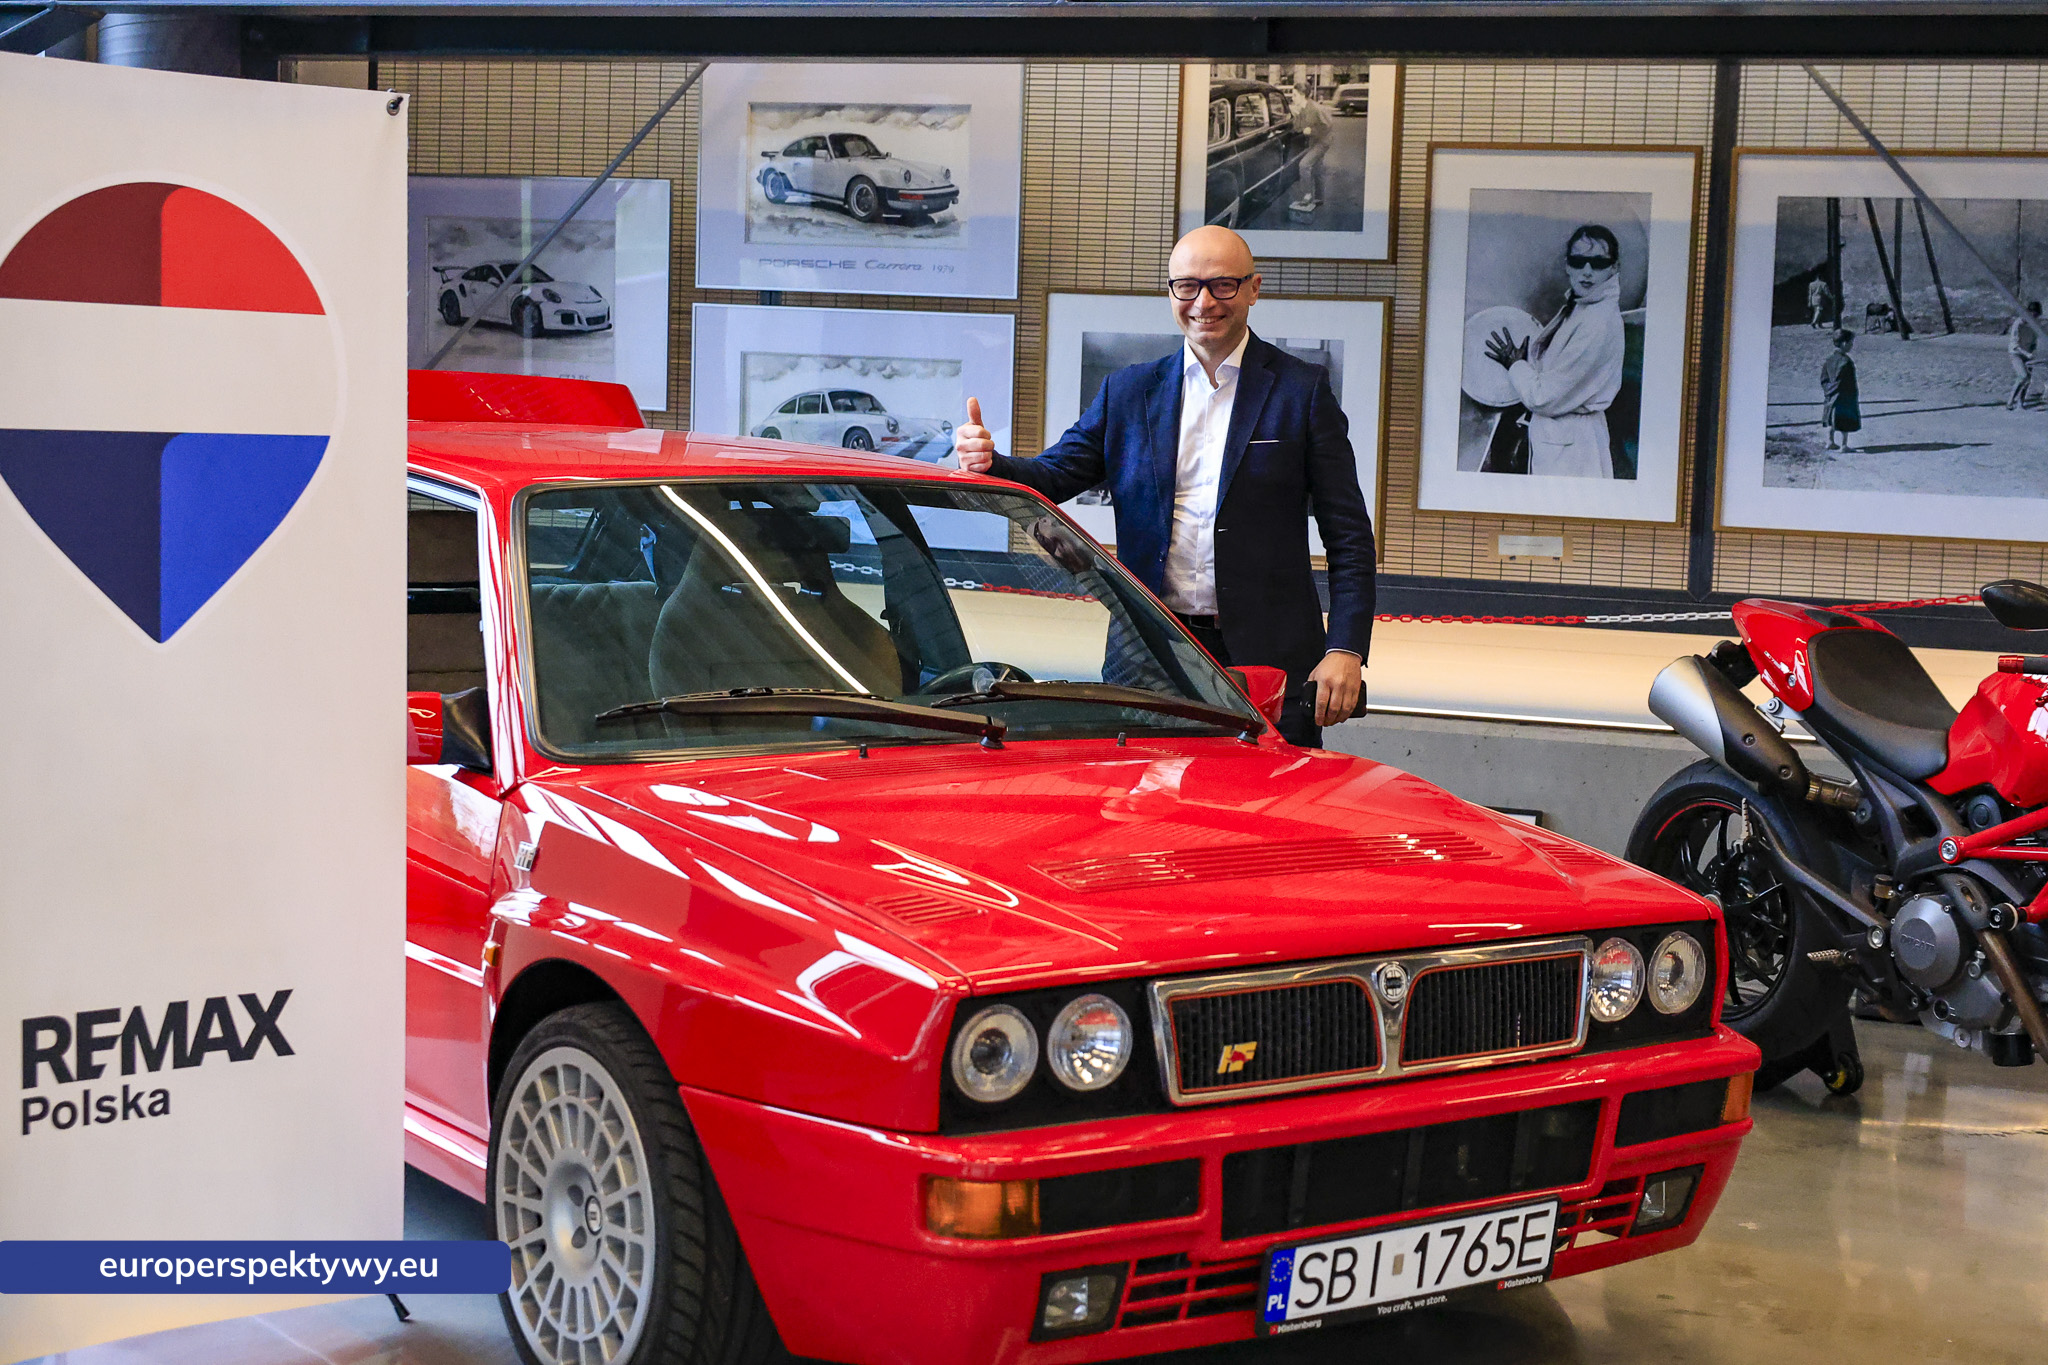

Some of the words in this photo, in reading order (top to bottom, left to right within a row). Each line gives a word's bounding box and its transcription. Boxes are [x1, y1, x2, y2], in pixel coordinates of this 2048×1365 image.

[759, 258, 857, 270] PORSCHE
[864, 259, 923, 271] Carrera
[22, 988, 296, 1090] REMAX
[22, 1084, 171, 1136] Polska
[1295, 1240, 1383, 1309] SBI
[1413, 1209, 1550, 1289] 1765E
[1504, 1274, 1544, 1289] Kistenberg
[1266, 1293, 1286, 1312] PL
[1377, 1305, 1392, 1316] You
[1414, 1299, 1426, 1308] we
[1426, 1294, 1448, 1306] store.
